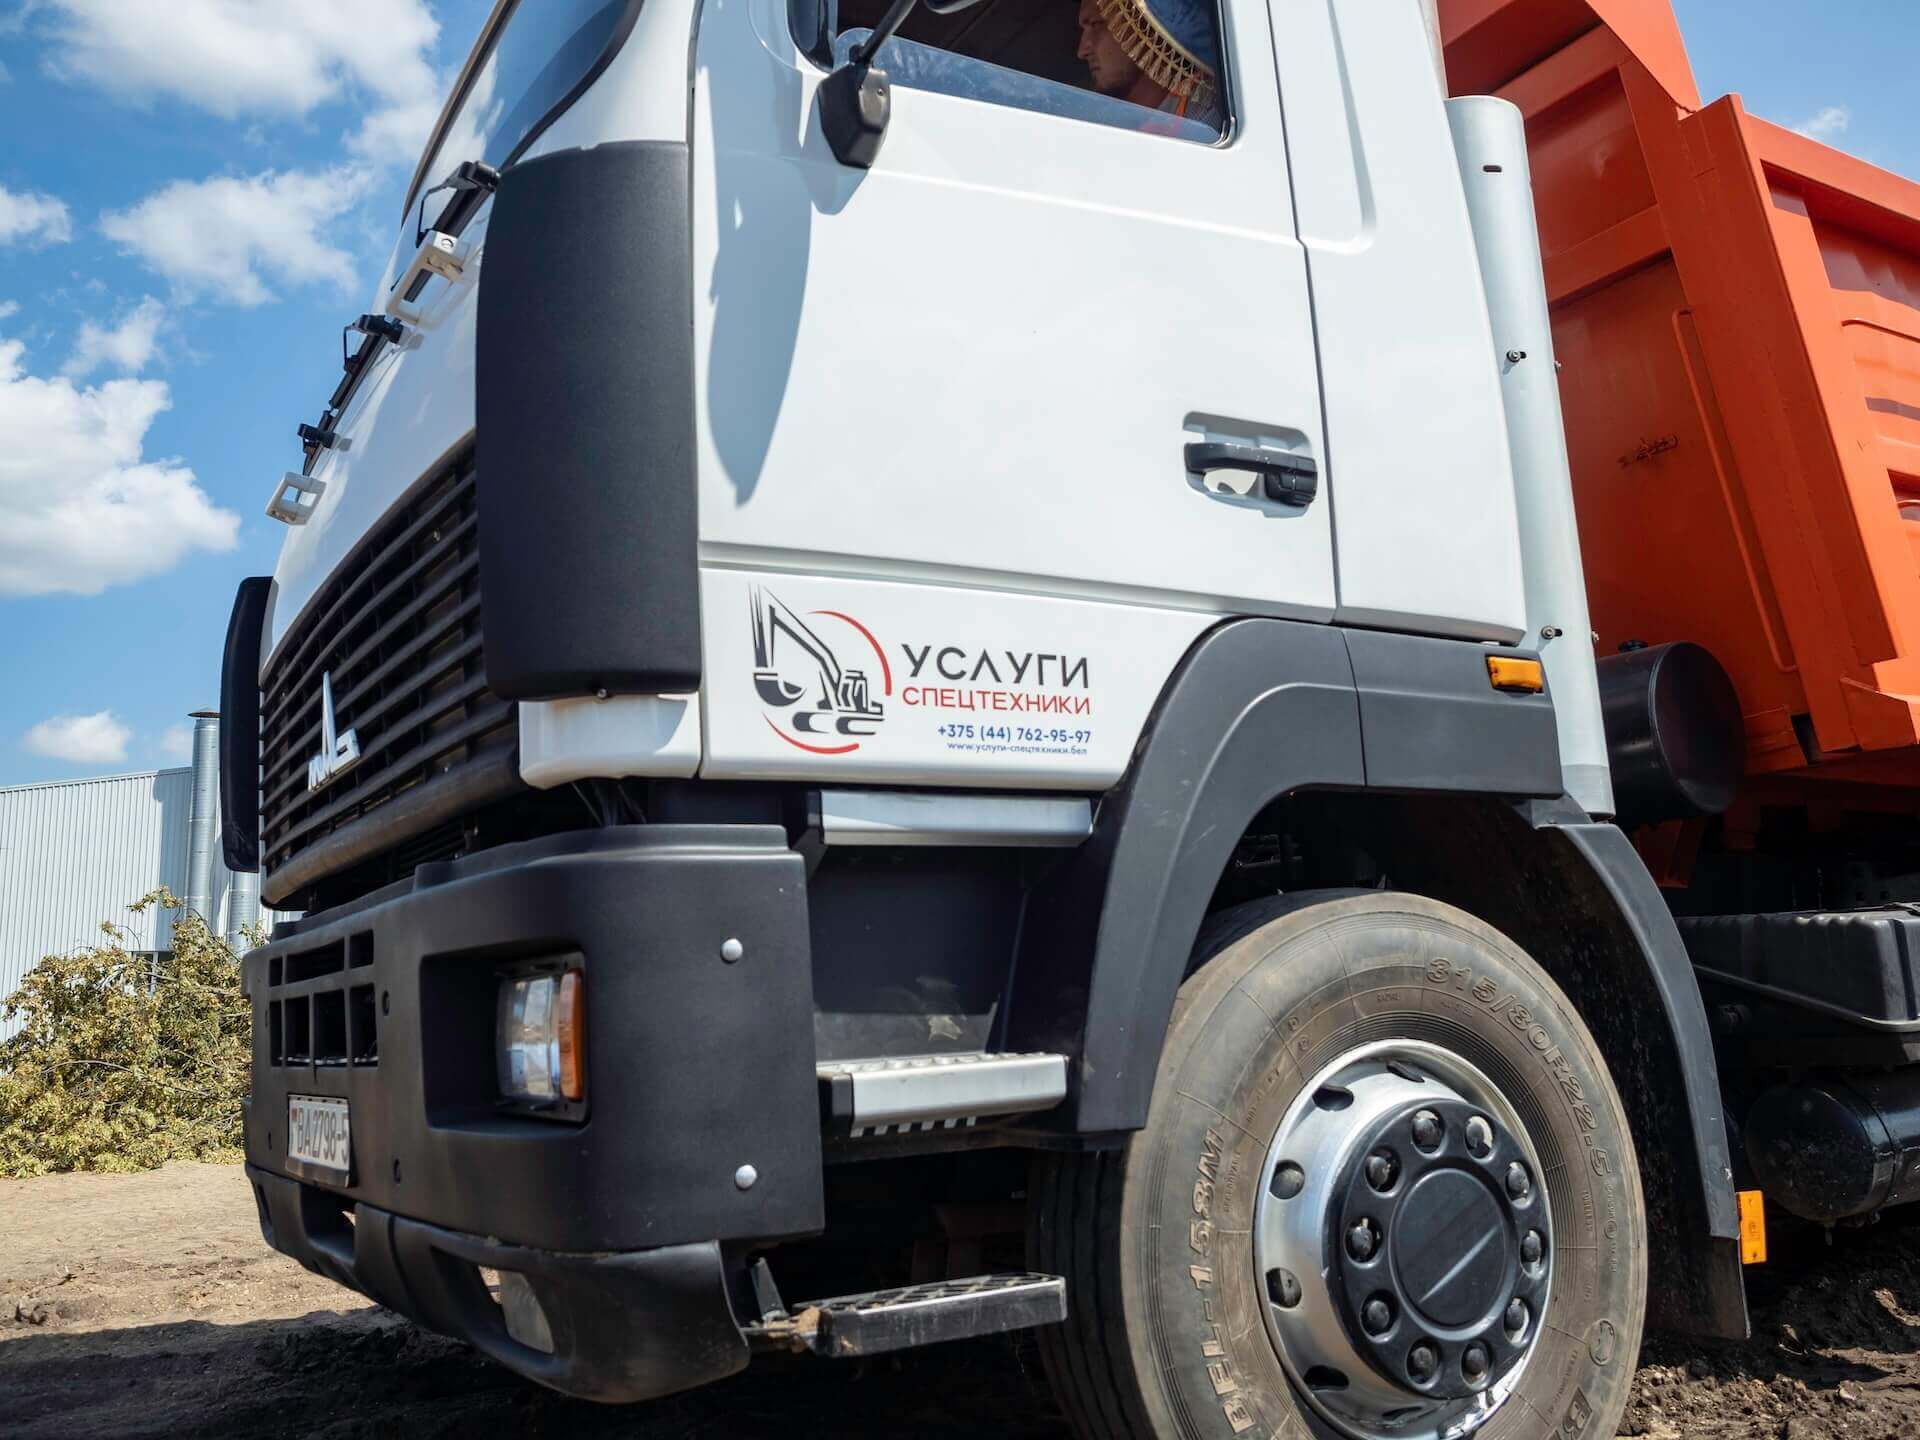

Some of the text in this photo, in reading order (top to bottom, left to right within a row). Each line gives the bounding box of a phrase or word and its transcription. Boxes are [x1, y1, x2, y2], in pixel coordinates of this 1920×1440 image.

[901, 643, 1089, 689] УСЛУГИ
[902, 686, 1091, 715] СПЕЦТЕХНИКИ
[937, 724, 1092, 744] +375 (44) 762-95-97
